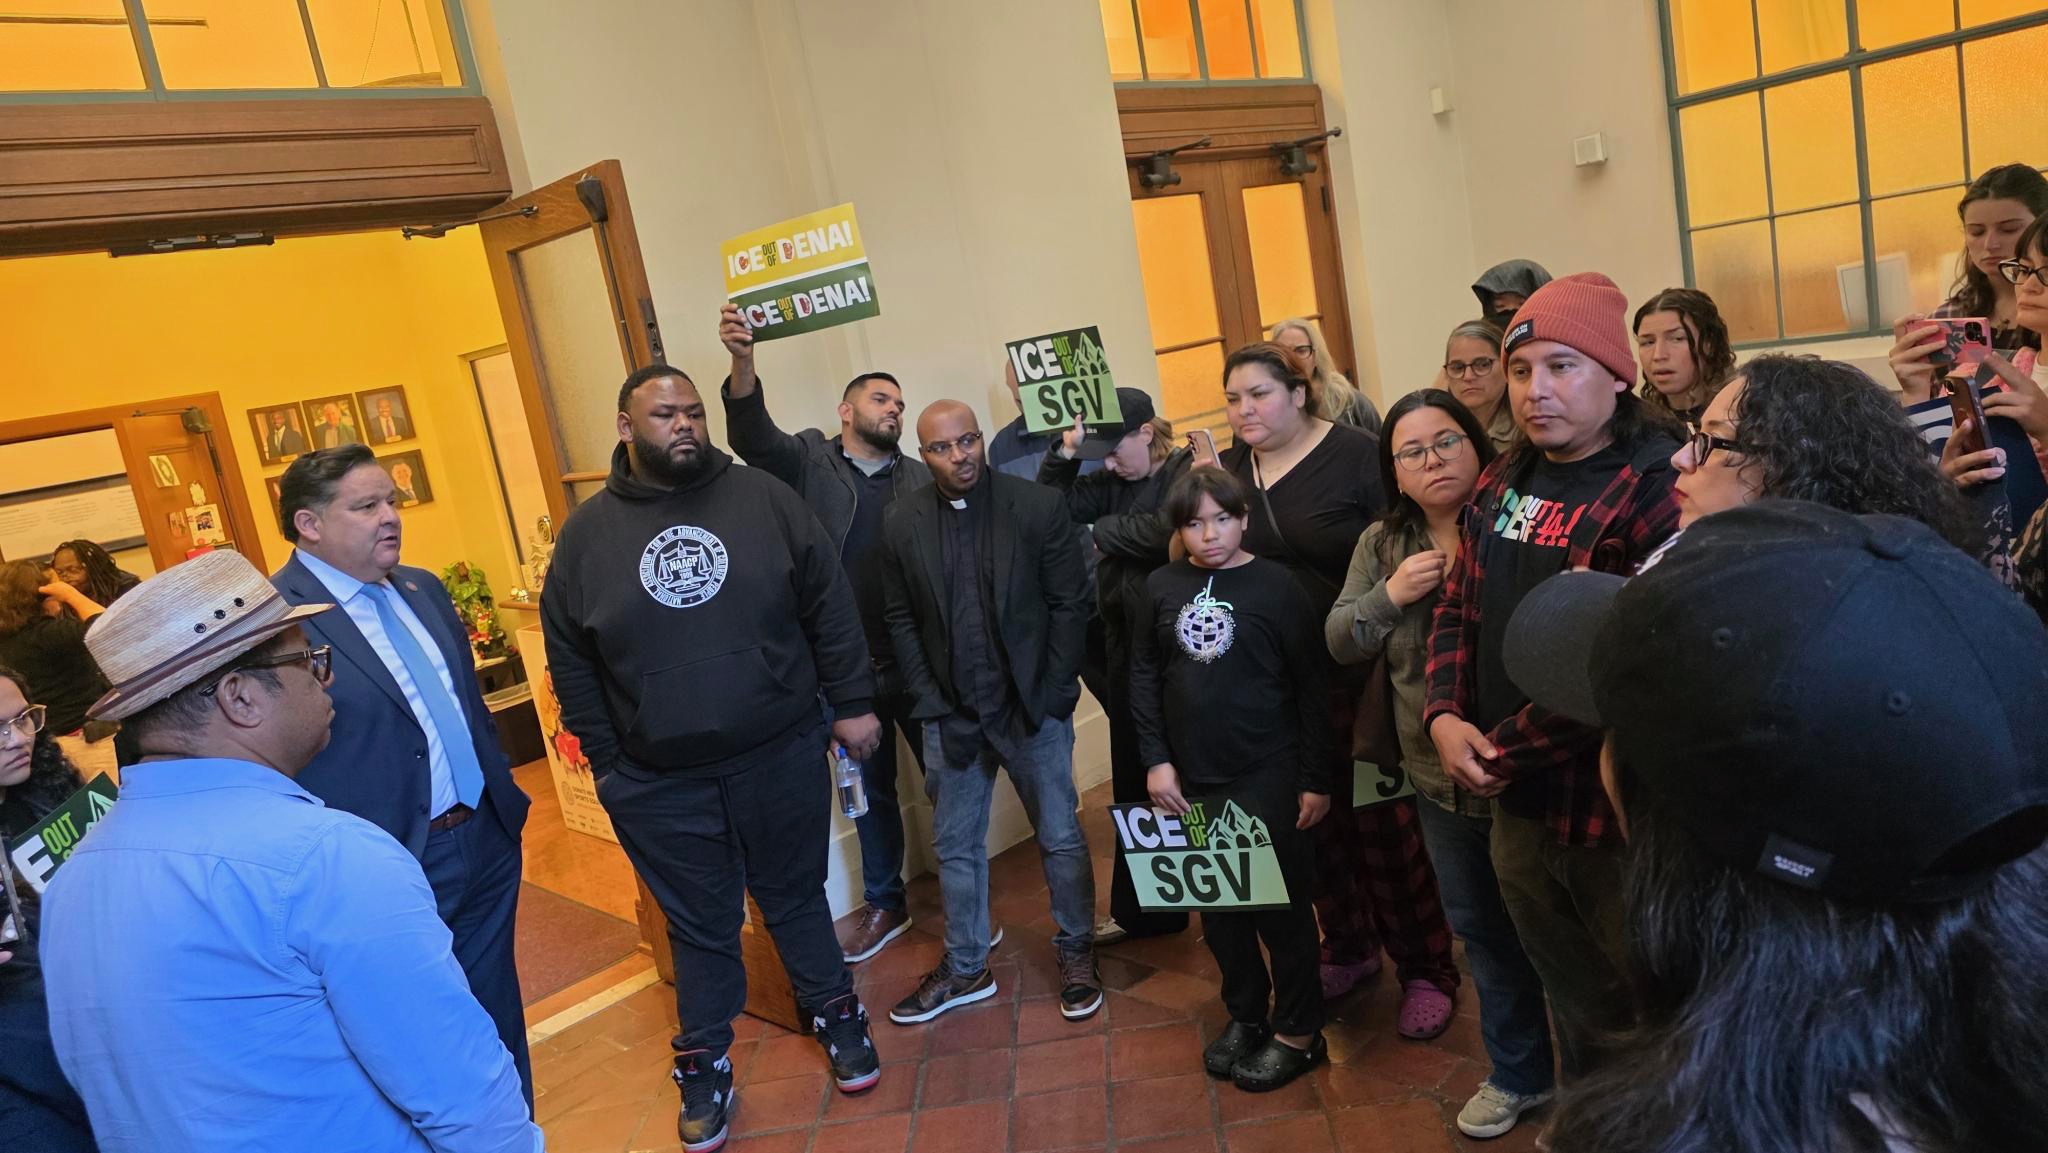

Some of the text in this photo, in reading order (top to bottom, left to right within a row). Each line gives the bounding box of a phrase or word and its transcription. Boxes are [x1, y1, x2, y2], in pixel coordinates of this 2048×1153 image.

[728, 221, 854, 279] ICE OUT OF DENA!
[777, 297, 793, 310] OUT
[792, 276, 871, 319] DENA!
[783, 308, 794, 321] OF
[1009, 336, 1075, 383] ICE OUT OF
[1038, 377, 1104, 426] SGV
[650, 539, 661, 550] FOR
[664, 531, 674, 540] THE
[677, 527, 718, 547] ADVANCEMENT
[669, 556, 698, 572] NAACP
[653, 587, 682, 605] NATIONAL
[699, 580, 719, 600] PEOPLE
[42, 811, 79, 855] OUT
[1112, 803, 1208, 850] ICE OUT OF
[1151, 851, 1252, 904] SGV
